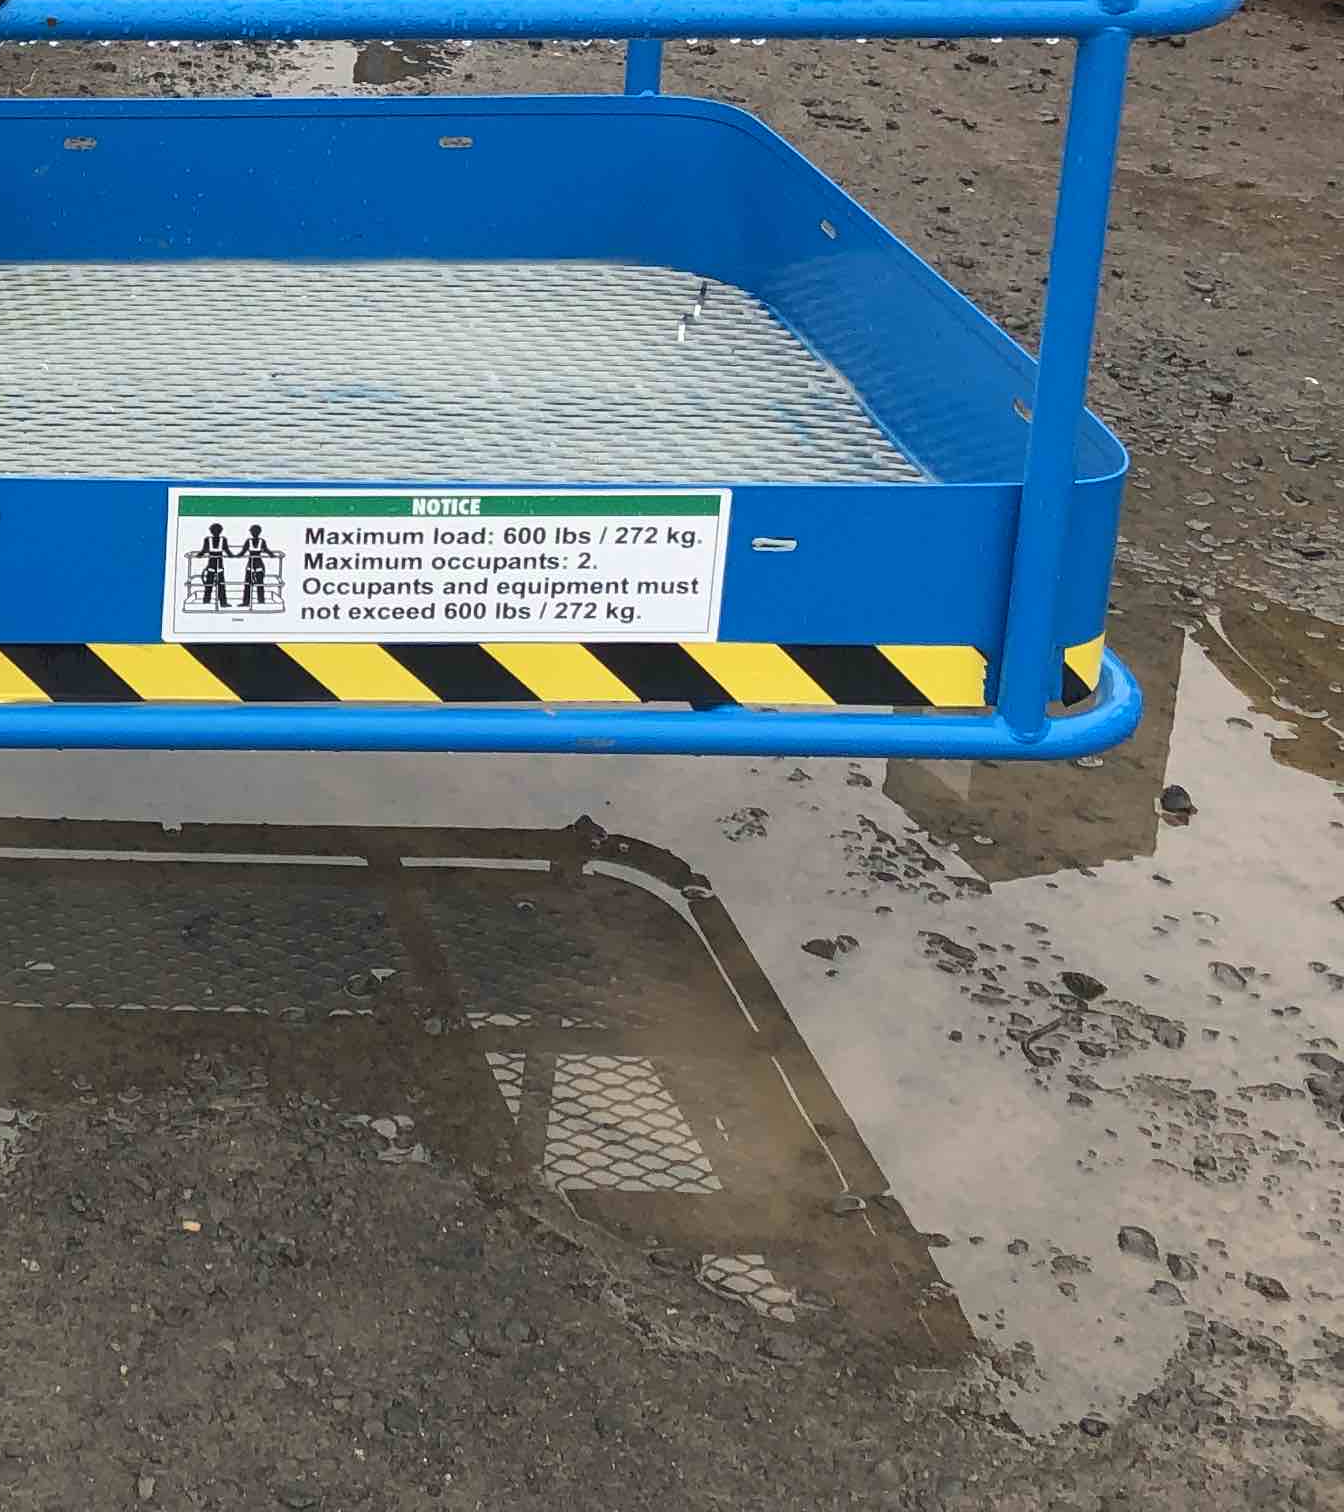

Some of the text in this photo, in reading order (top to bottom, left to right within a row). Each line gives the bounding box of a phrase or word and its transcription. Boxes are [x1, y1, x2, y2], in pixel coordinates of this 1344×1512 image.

[412, 498, 481, 515] NOTICE
[305, 526, 702, 549] Maximum load: 600 lbs / 272 kg.
[304, 552, 598, 575] Maximum occupants: 2.
[302, 577, 699, 599] Occupants and equipment must
[301, 602, 641, 624] not exceed 600 lbs / 272 kg.
